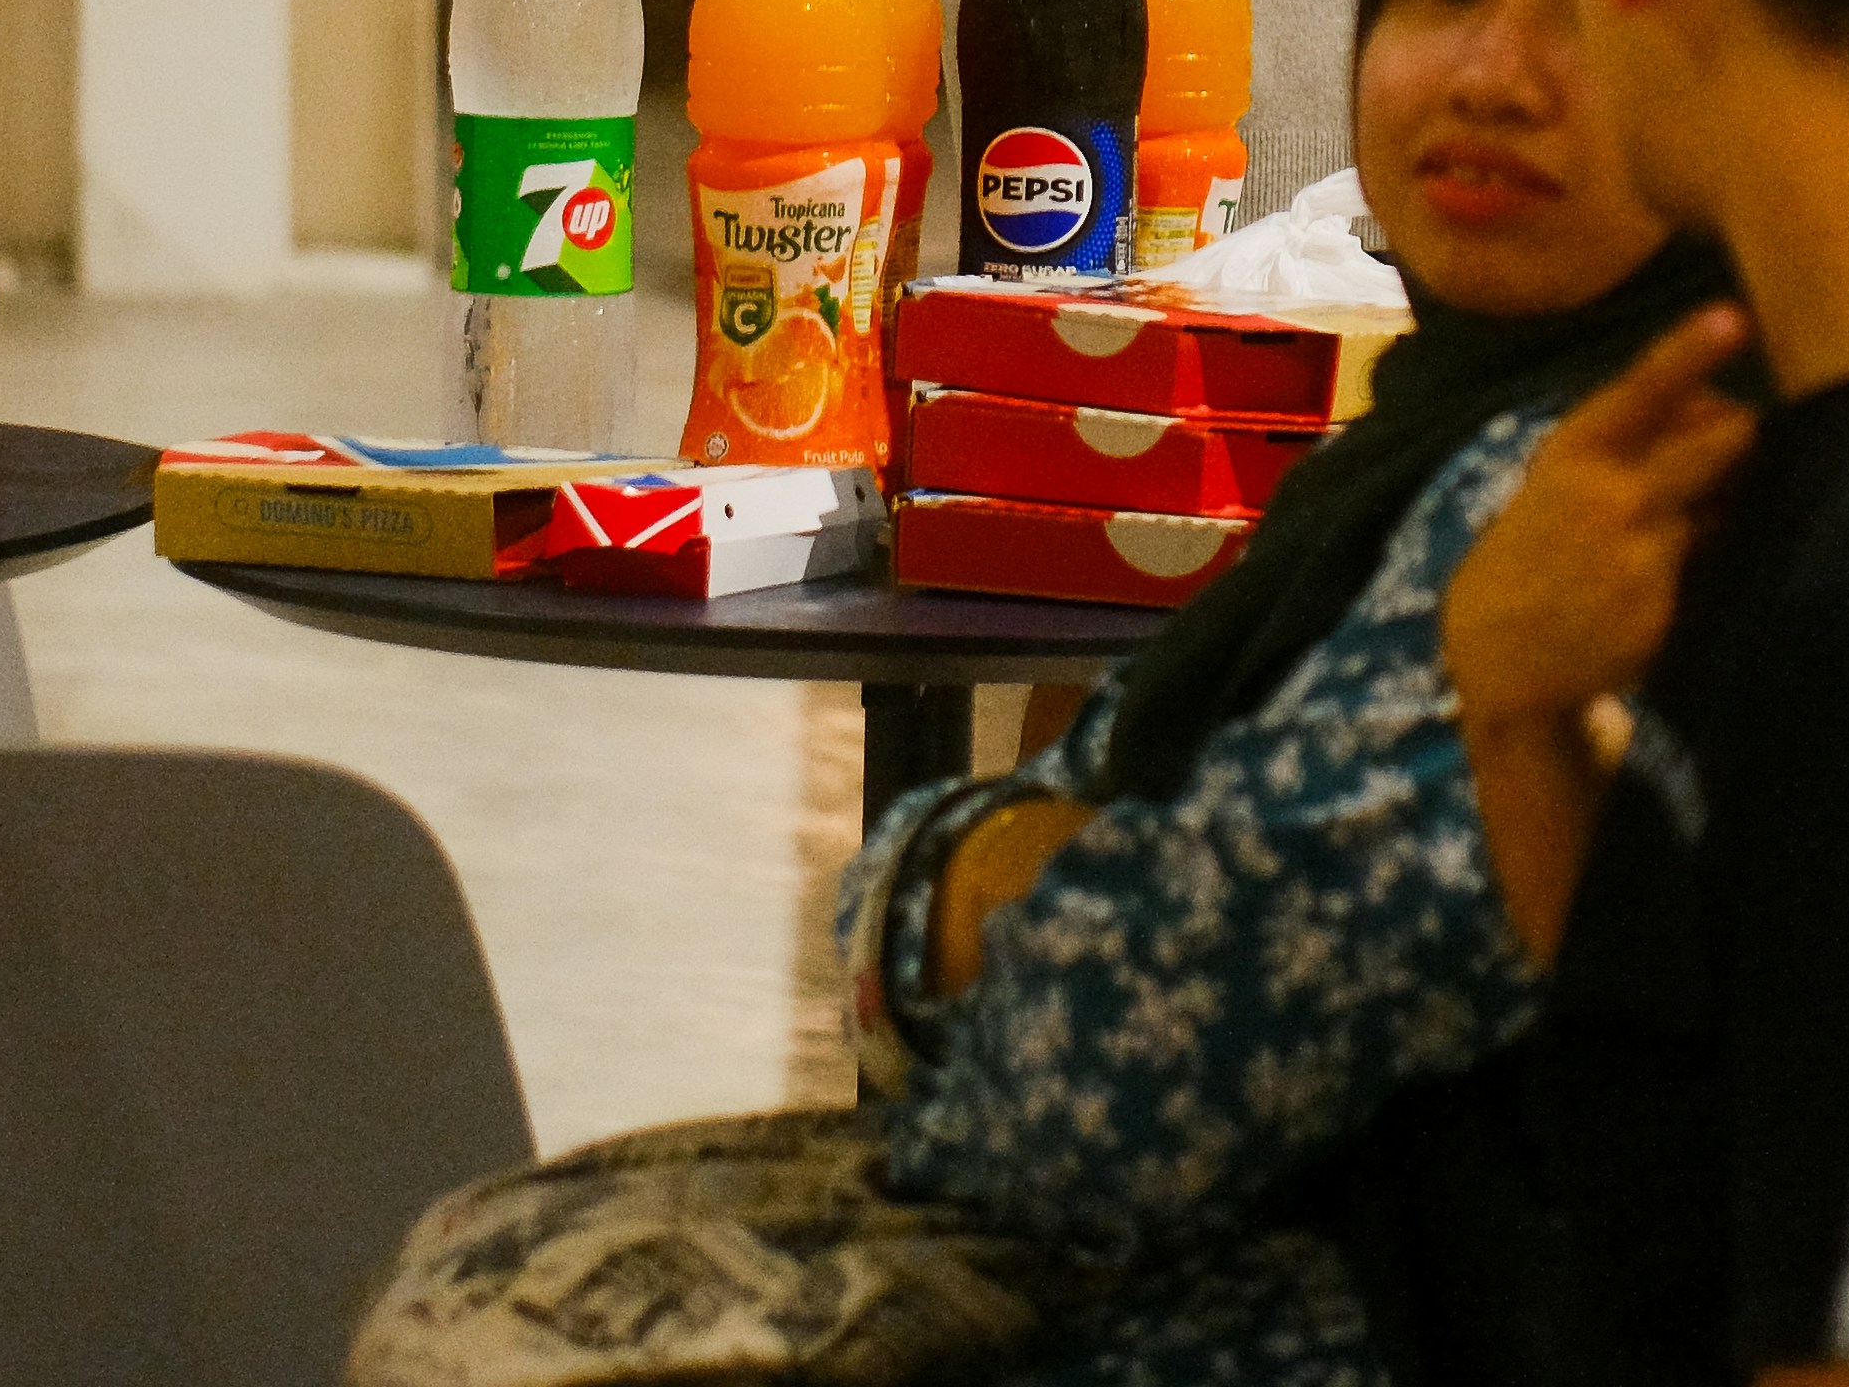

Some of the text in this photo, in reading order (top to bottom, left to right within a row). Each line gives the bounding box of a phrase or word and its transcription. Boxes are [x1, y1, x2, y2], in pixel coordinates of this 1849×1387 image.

[982, 173, 1085, 203] PEPSI
[770, 195, 845, 221] Tropicana
[713, 207, 852, 263] Twister
[982, 261, 1019, 273] ZERO
[734, 304, 757, 335] C
[803, 448, 837, 464] Fruit
